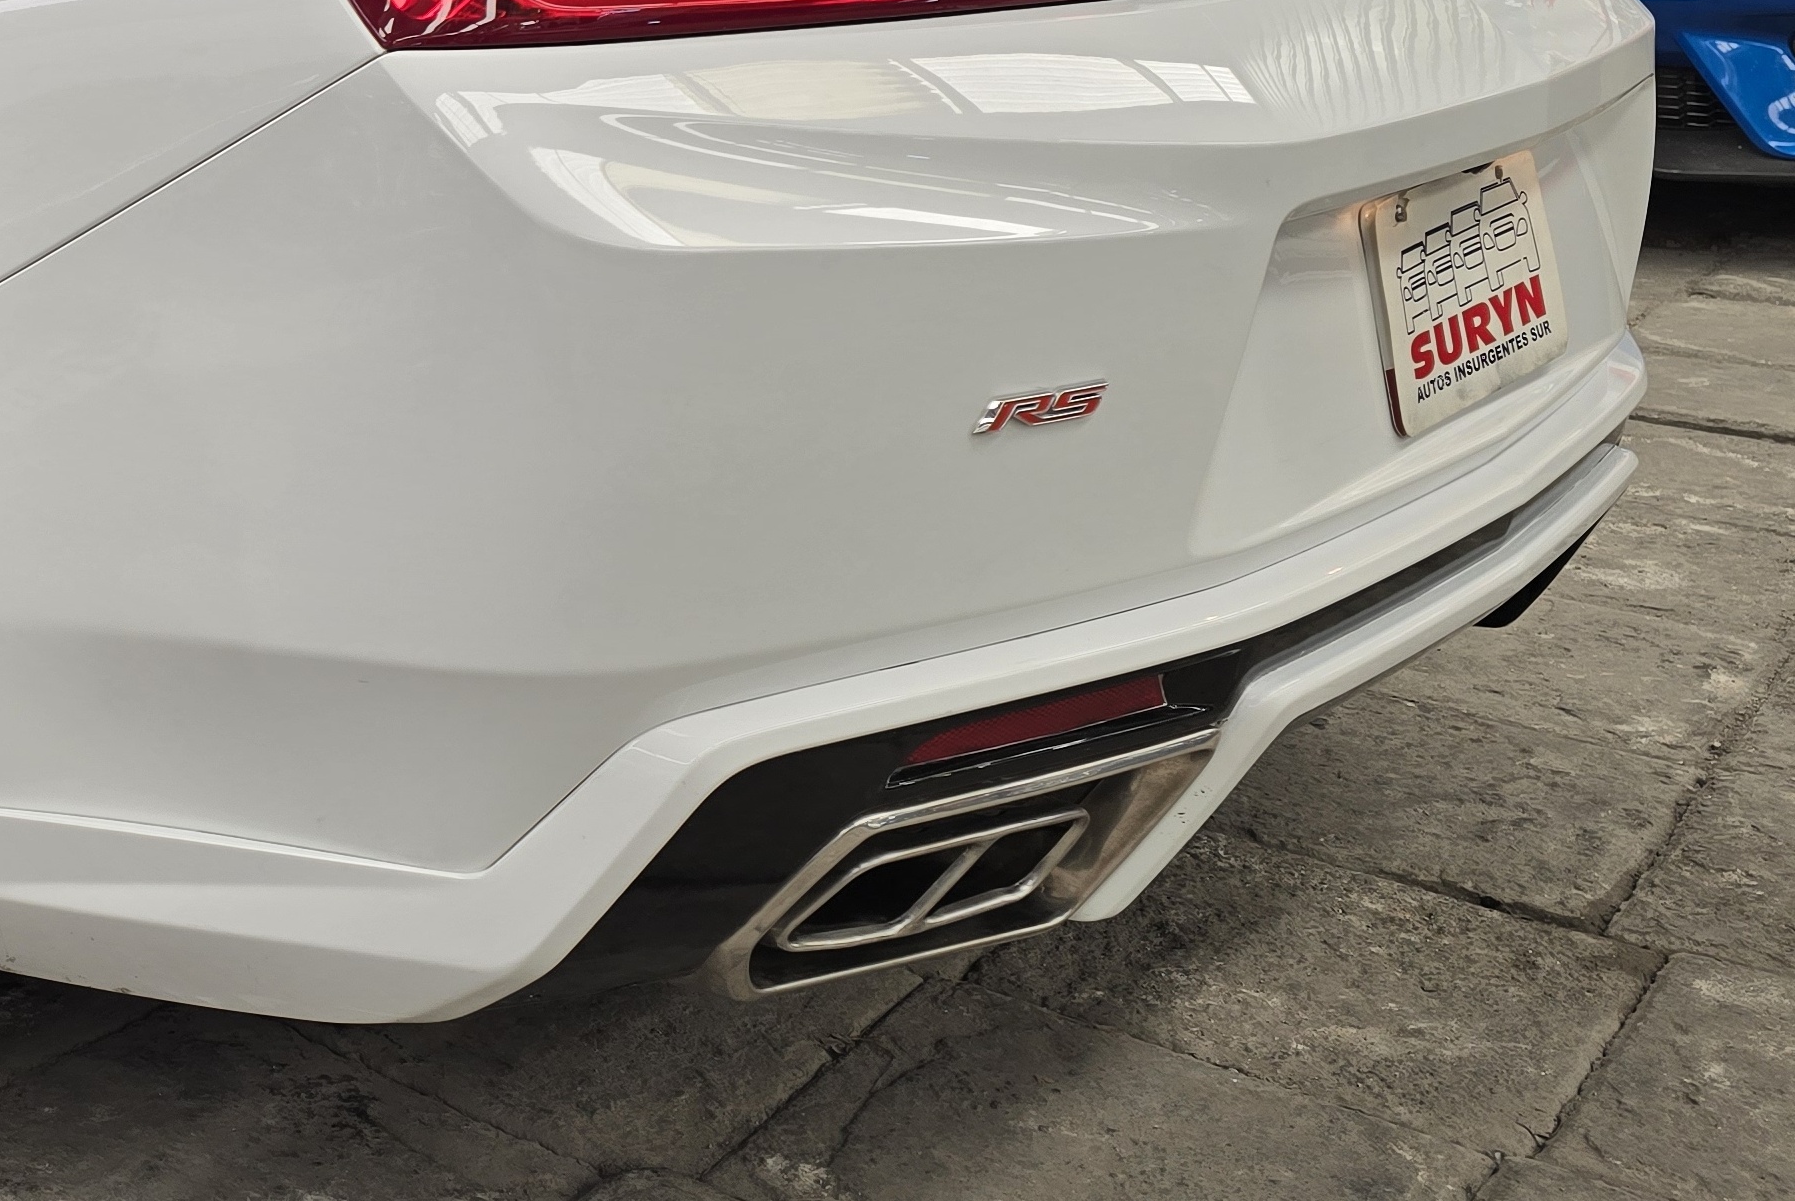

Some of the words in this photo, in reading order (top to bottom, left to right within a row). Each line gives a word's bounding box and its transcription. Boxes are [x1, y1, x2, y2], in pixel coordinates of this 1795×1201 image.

[1410, 273, 1547, 380] SURYN
[1417, 371, 1452, 404] AUTOS
[1454, 332, 1529, 383] INSURGENTES
[1530, 320, 1552, 342] SUR
[973, 380, 1109, 433] RS
